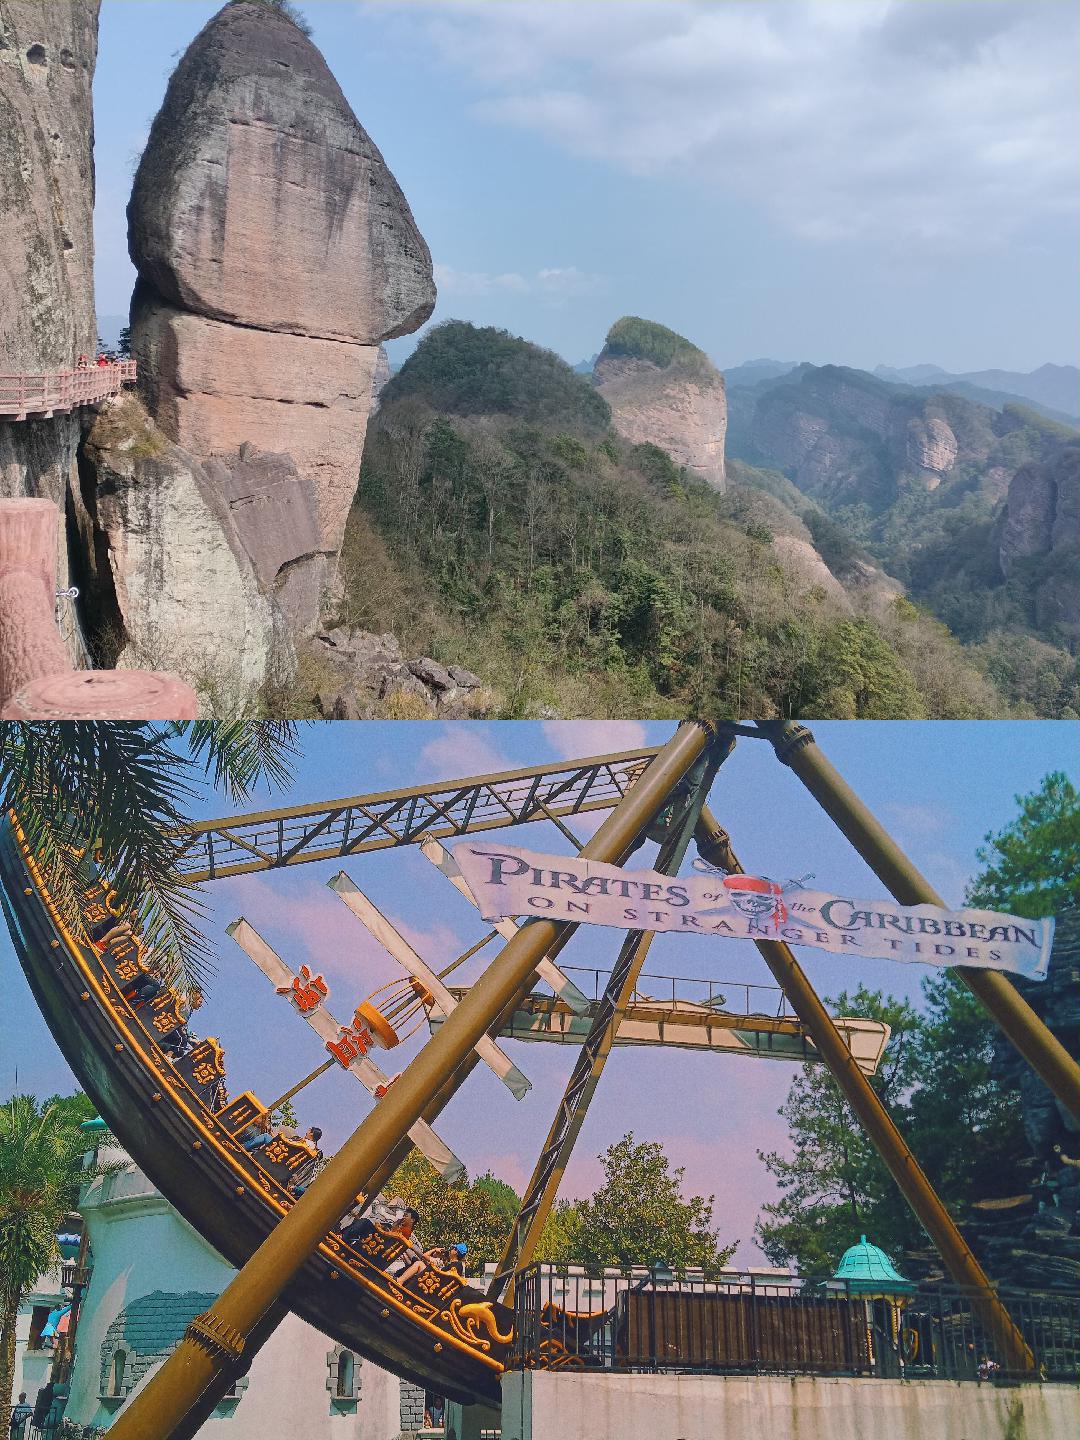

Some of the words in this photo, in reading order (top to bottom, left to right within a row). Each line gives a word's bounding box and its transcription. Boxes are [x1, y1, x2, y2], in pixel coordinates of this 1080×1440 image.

[469, 849, 690, 907] PIRATES
[703, 891, 724, 902] of
[791, 901, 816, 913] the
[819, 899, 1042, 949] CARIBBEAN
[527, 897, 589, 914] ON
[624, 908, 862, 946] STRANGER
[884, 938, 1002, 960] TIDES
[276, 965, 402, 1098] 海盗
